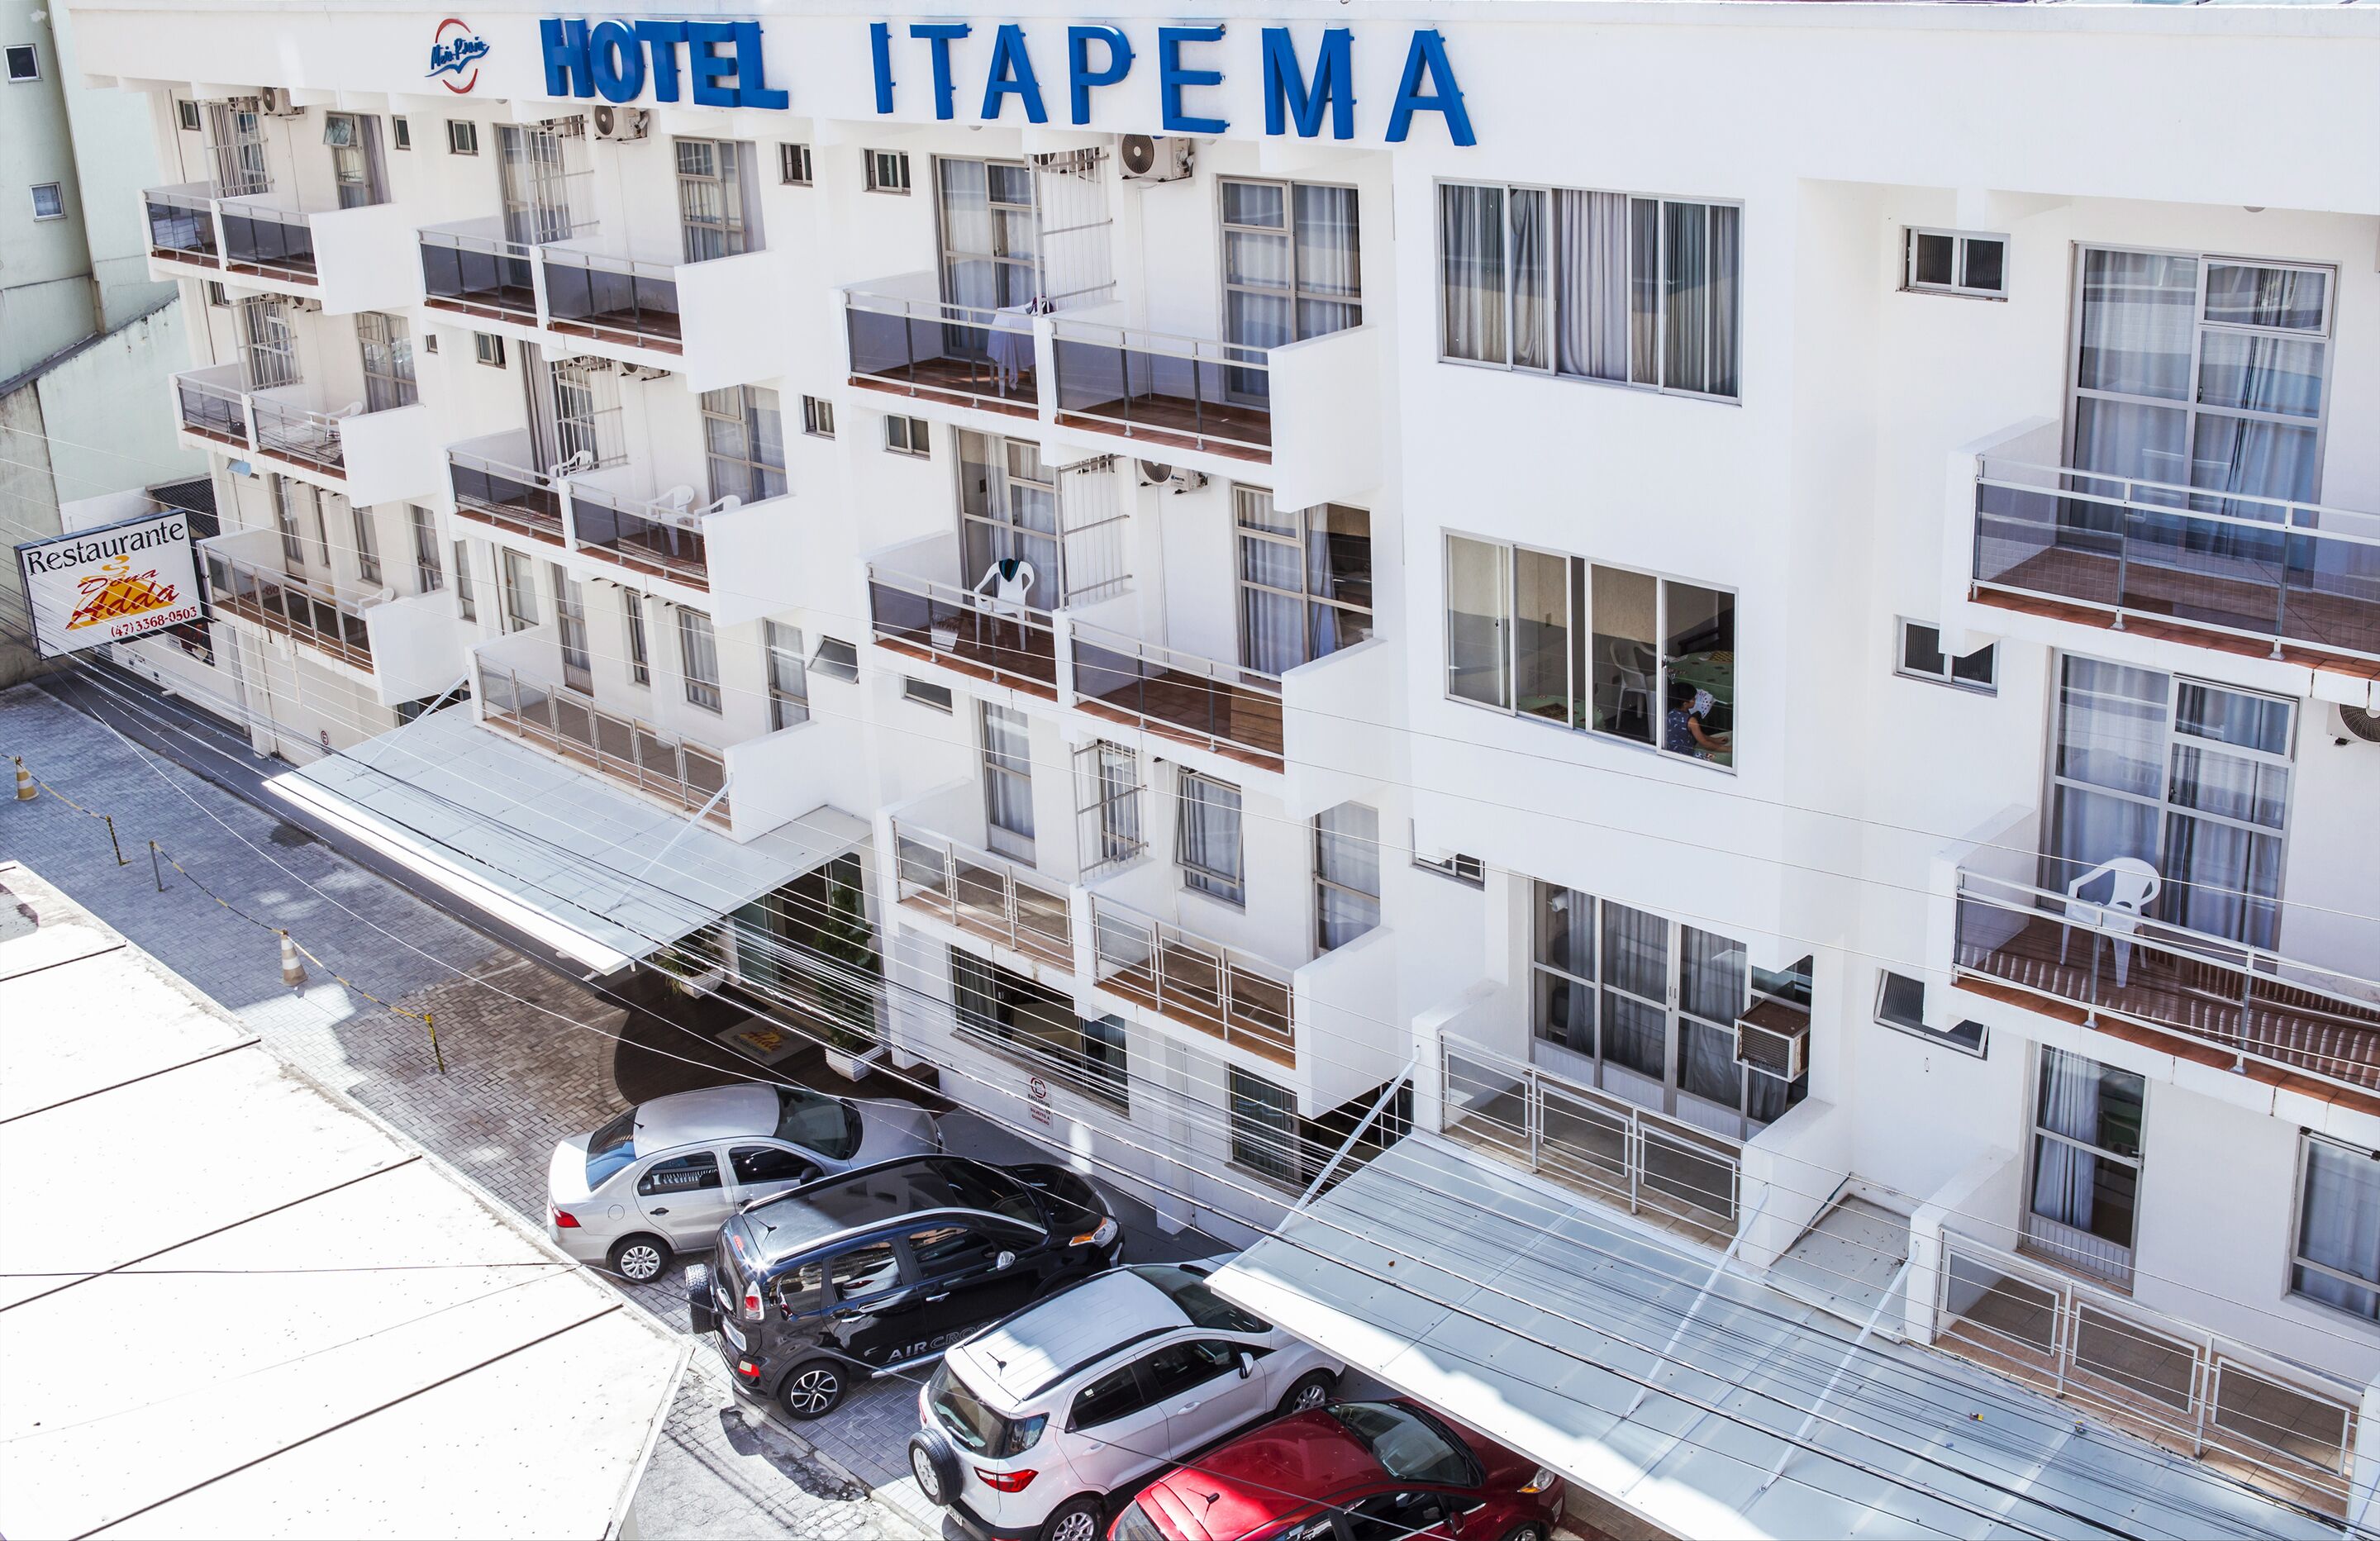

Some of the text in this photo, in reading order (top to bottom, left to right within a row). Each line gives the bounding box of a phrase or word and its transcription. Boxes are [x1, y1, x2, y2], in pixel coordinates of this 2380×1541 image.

[540, 18, 1477, 146] HOTEL ITAPEMA
[26, 521, 185, 576] Restaurante
[66, 581, 179, 630] Adda
[78, 569, 159, 595] Dona
